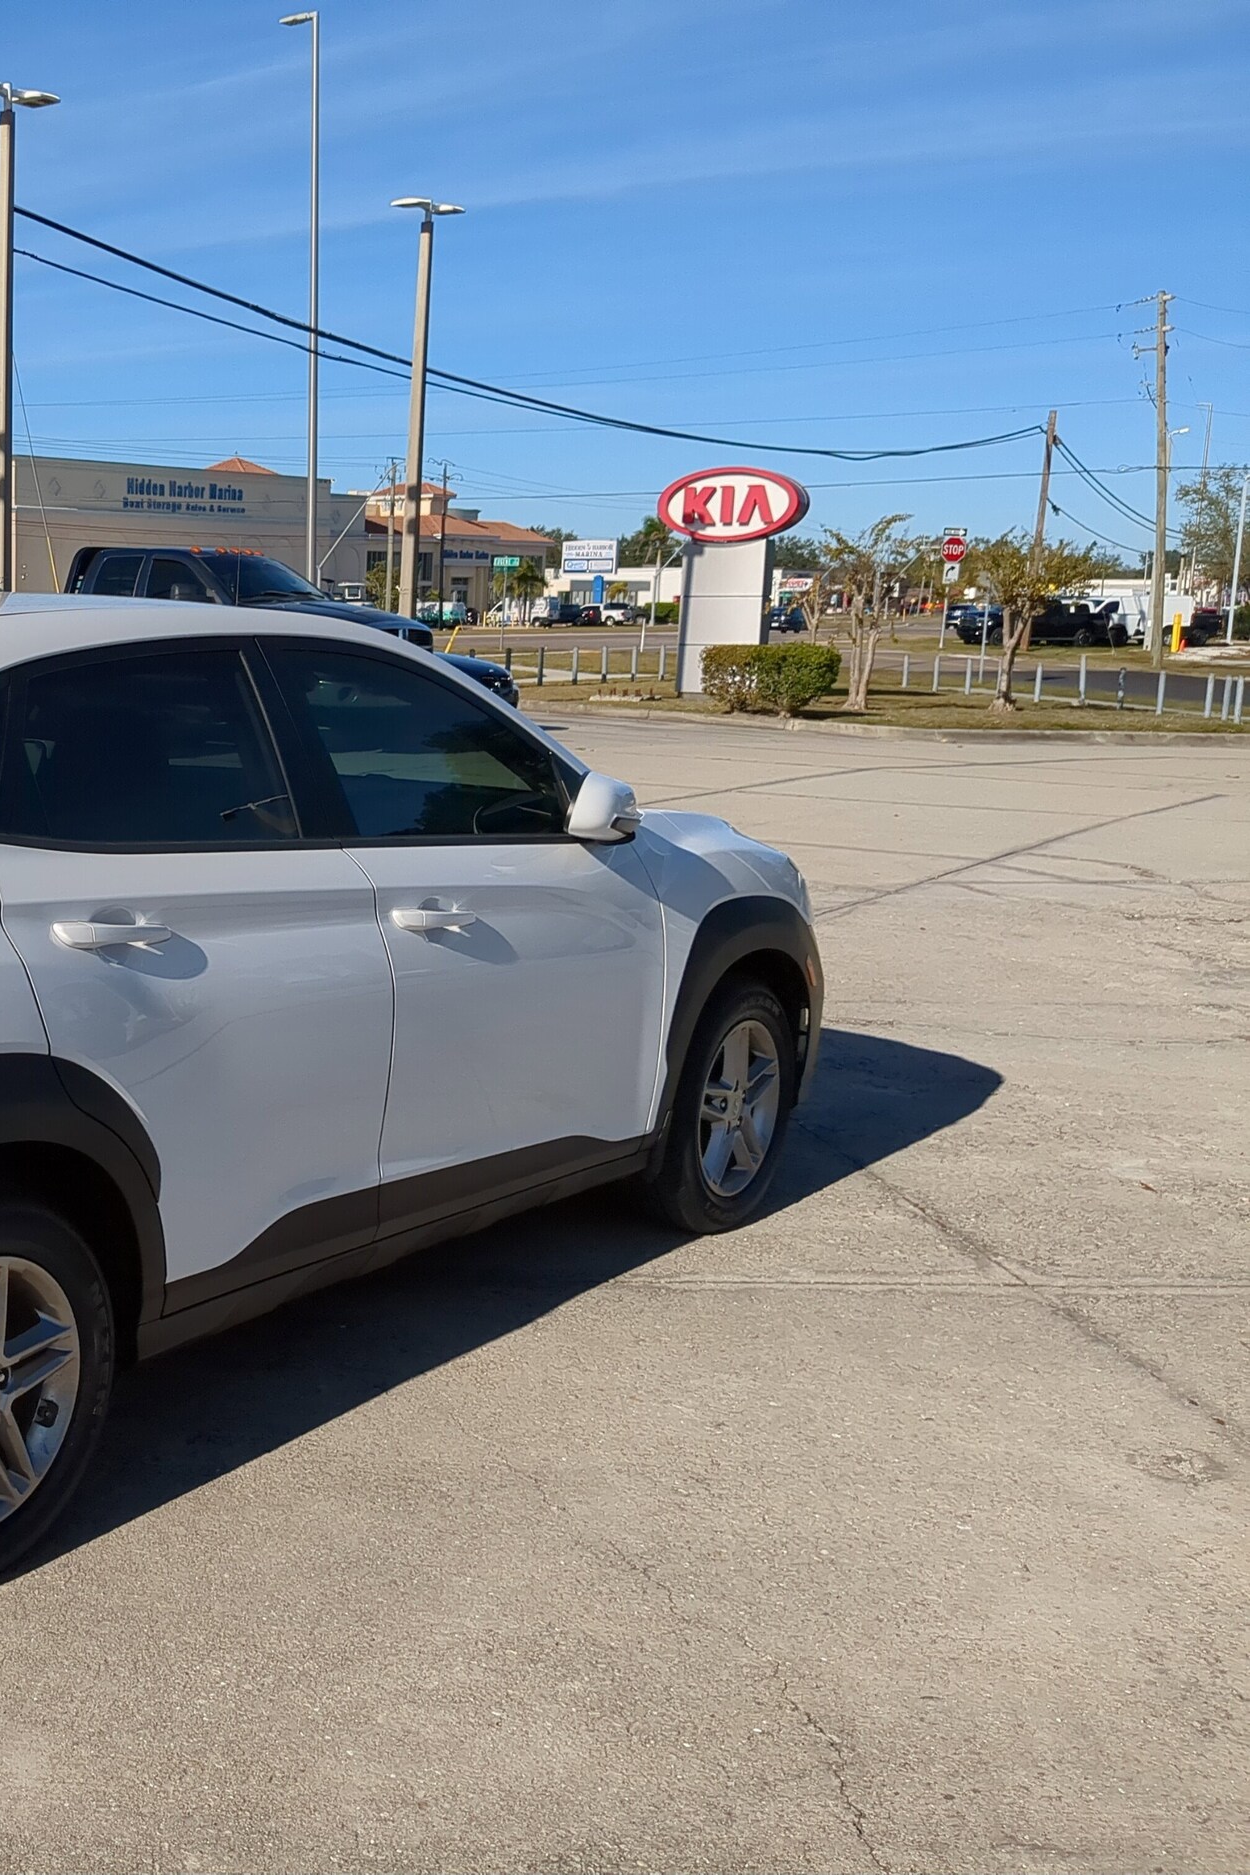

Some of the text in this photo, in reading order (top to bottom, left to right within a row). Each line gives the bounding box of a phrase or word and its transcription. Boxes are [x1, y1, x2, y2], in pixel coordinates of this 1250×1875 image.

[126, 477, 244, 501] Hidden Harbor Marina
[122, 496, 247, 514] Boat Storage Sales & Service
[682, 484, 774, 526] KIA
[942, 544, 964, 556] STOP
